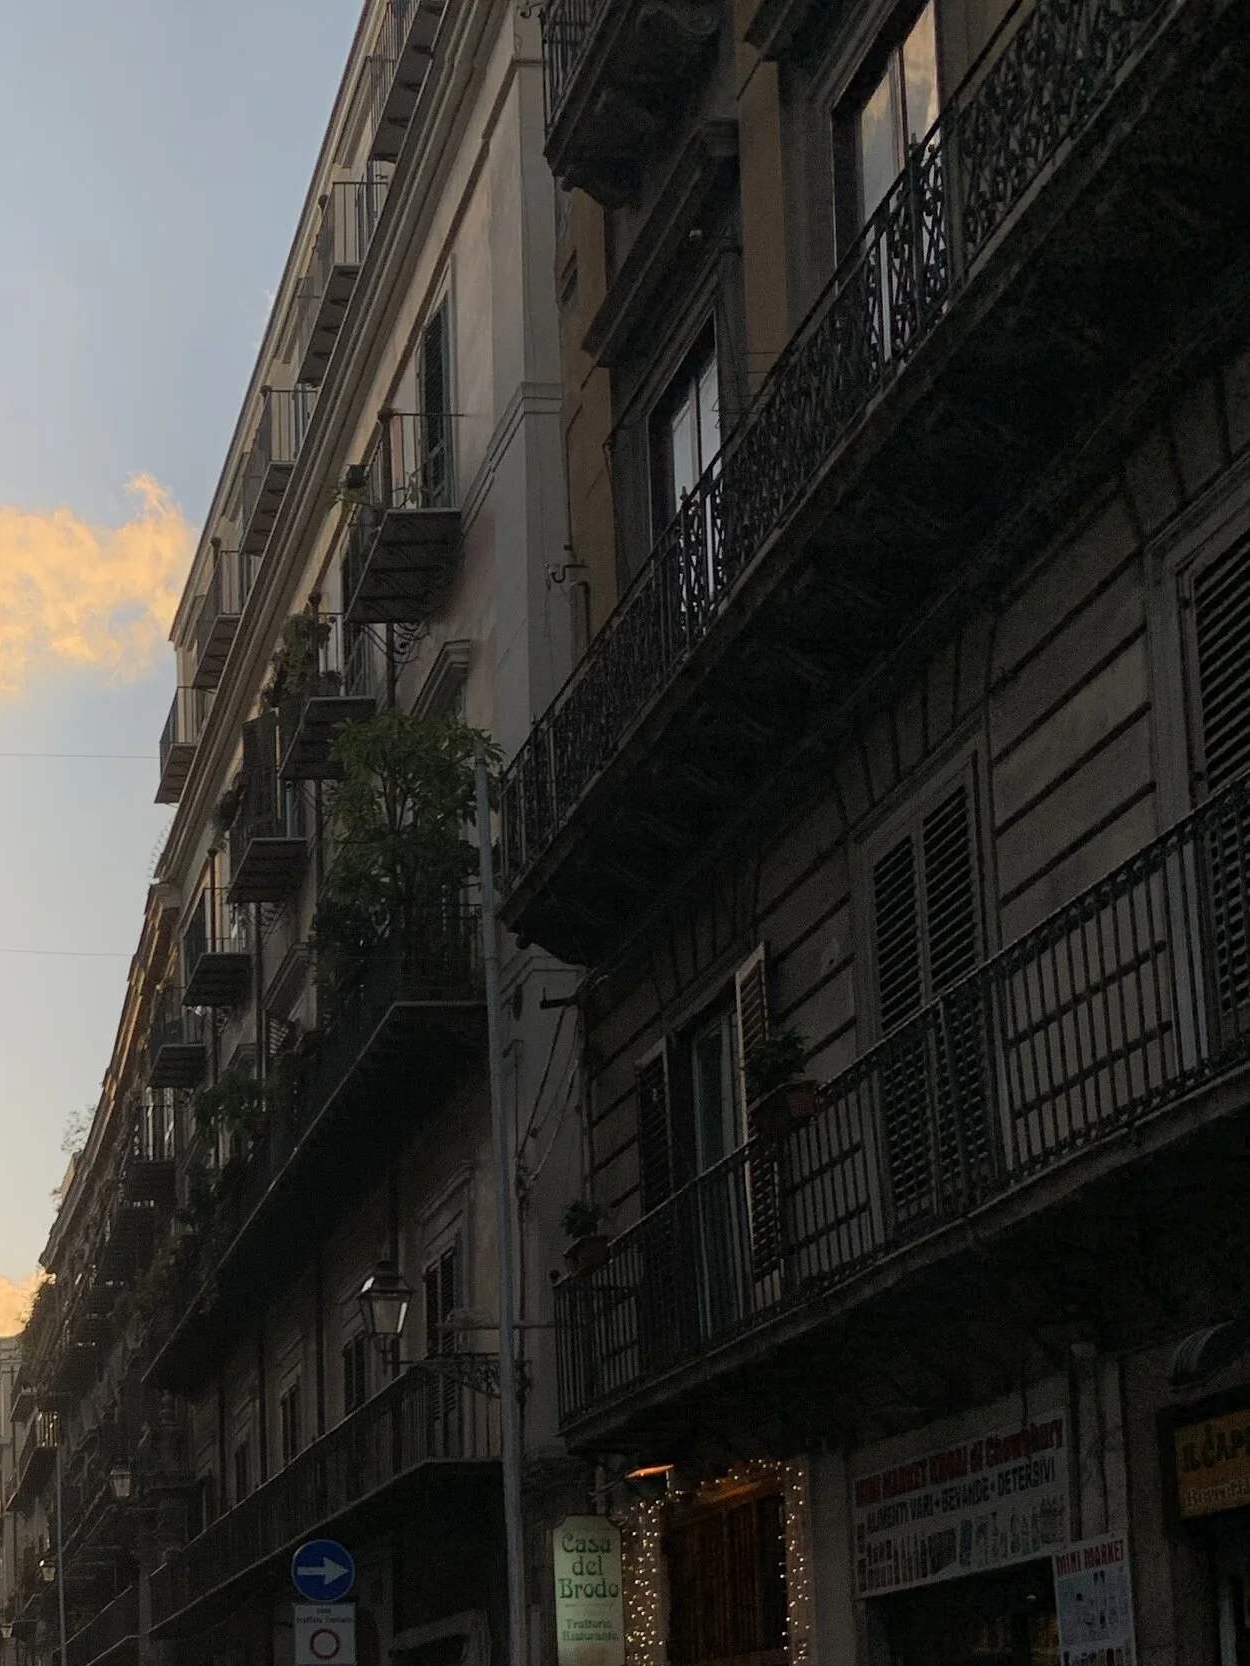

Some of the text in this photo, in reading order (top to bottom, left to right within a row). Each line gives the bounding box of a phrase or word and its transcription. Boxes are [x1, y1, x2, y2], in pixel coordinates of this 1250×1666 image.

[941, 1476, 991, 1513] BEVANDE
[997, 1456, 1055, 1497] DETERSIVI
[562, 1533, 611, 1554] Casa
[572, 1555, 604, 1576] del
[1056, 1540, 1124, 1576] MINI MARKET
[558, 1578, 619, 1599] Brodo
